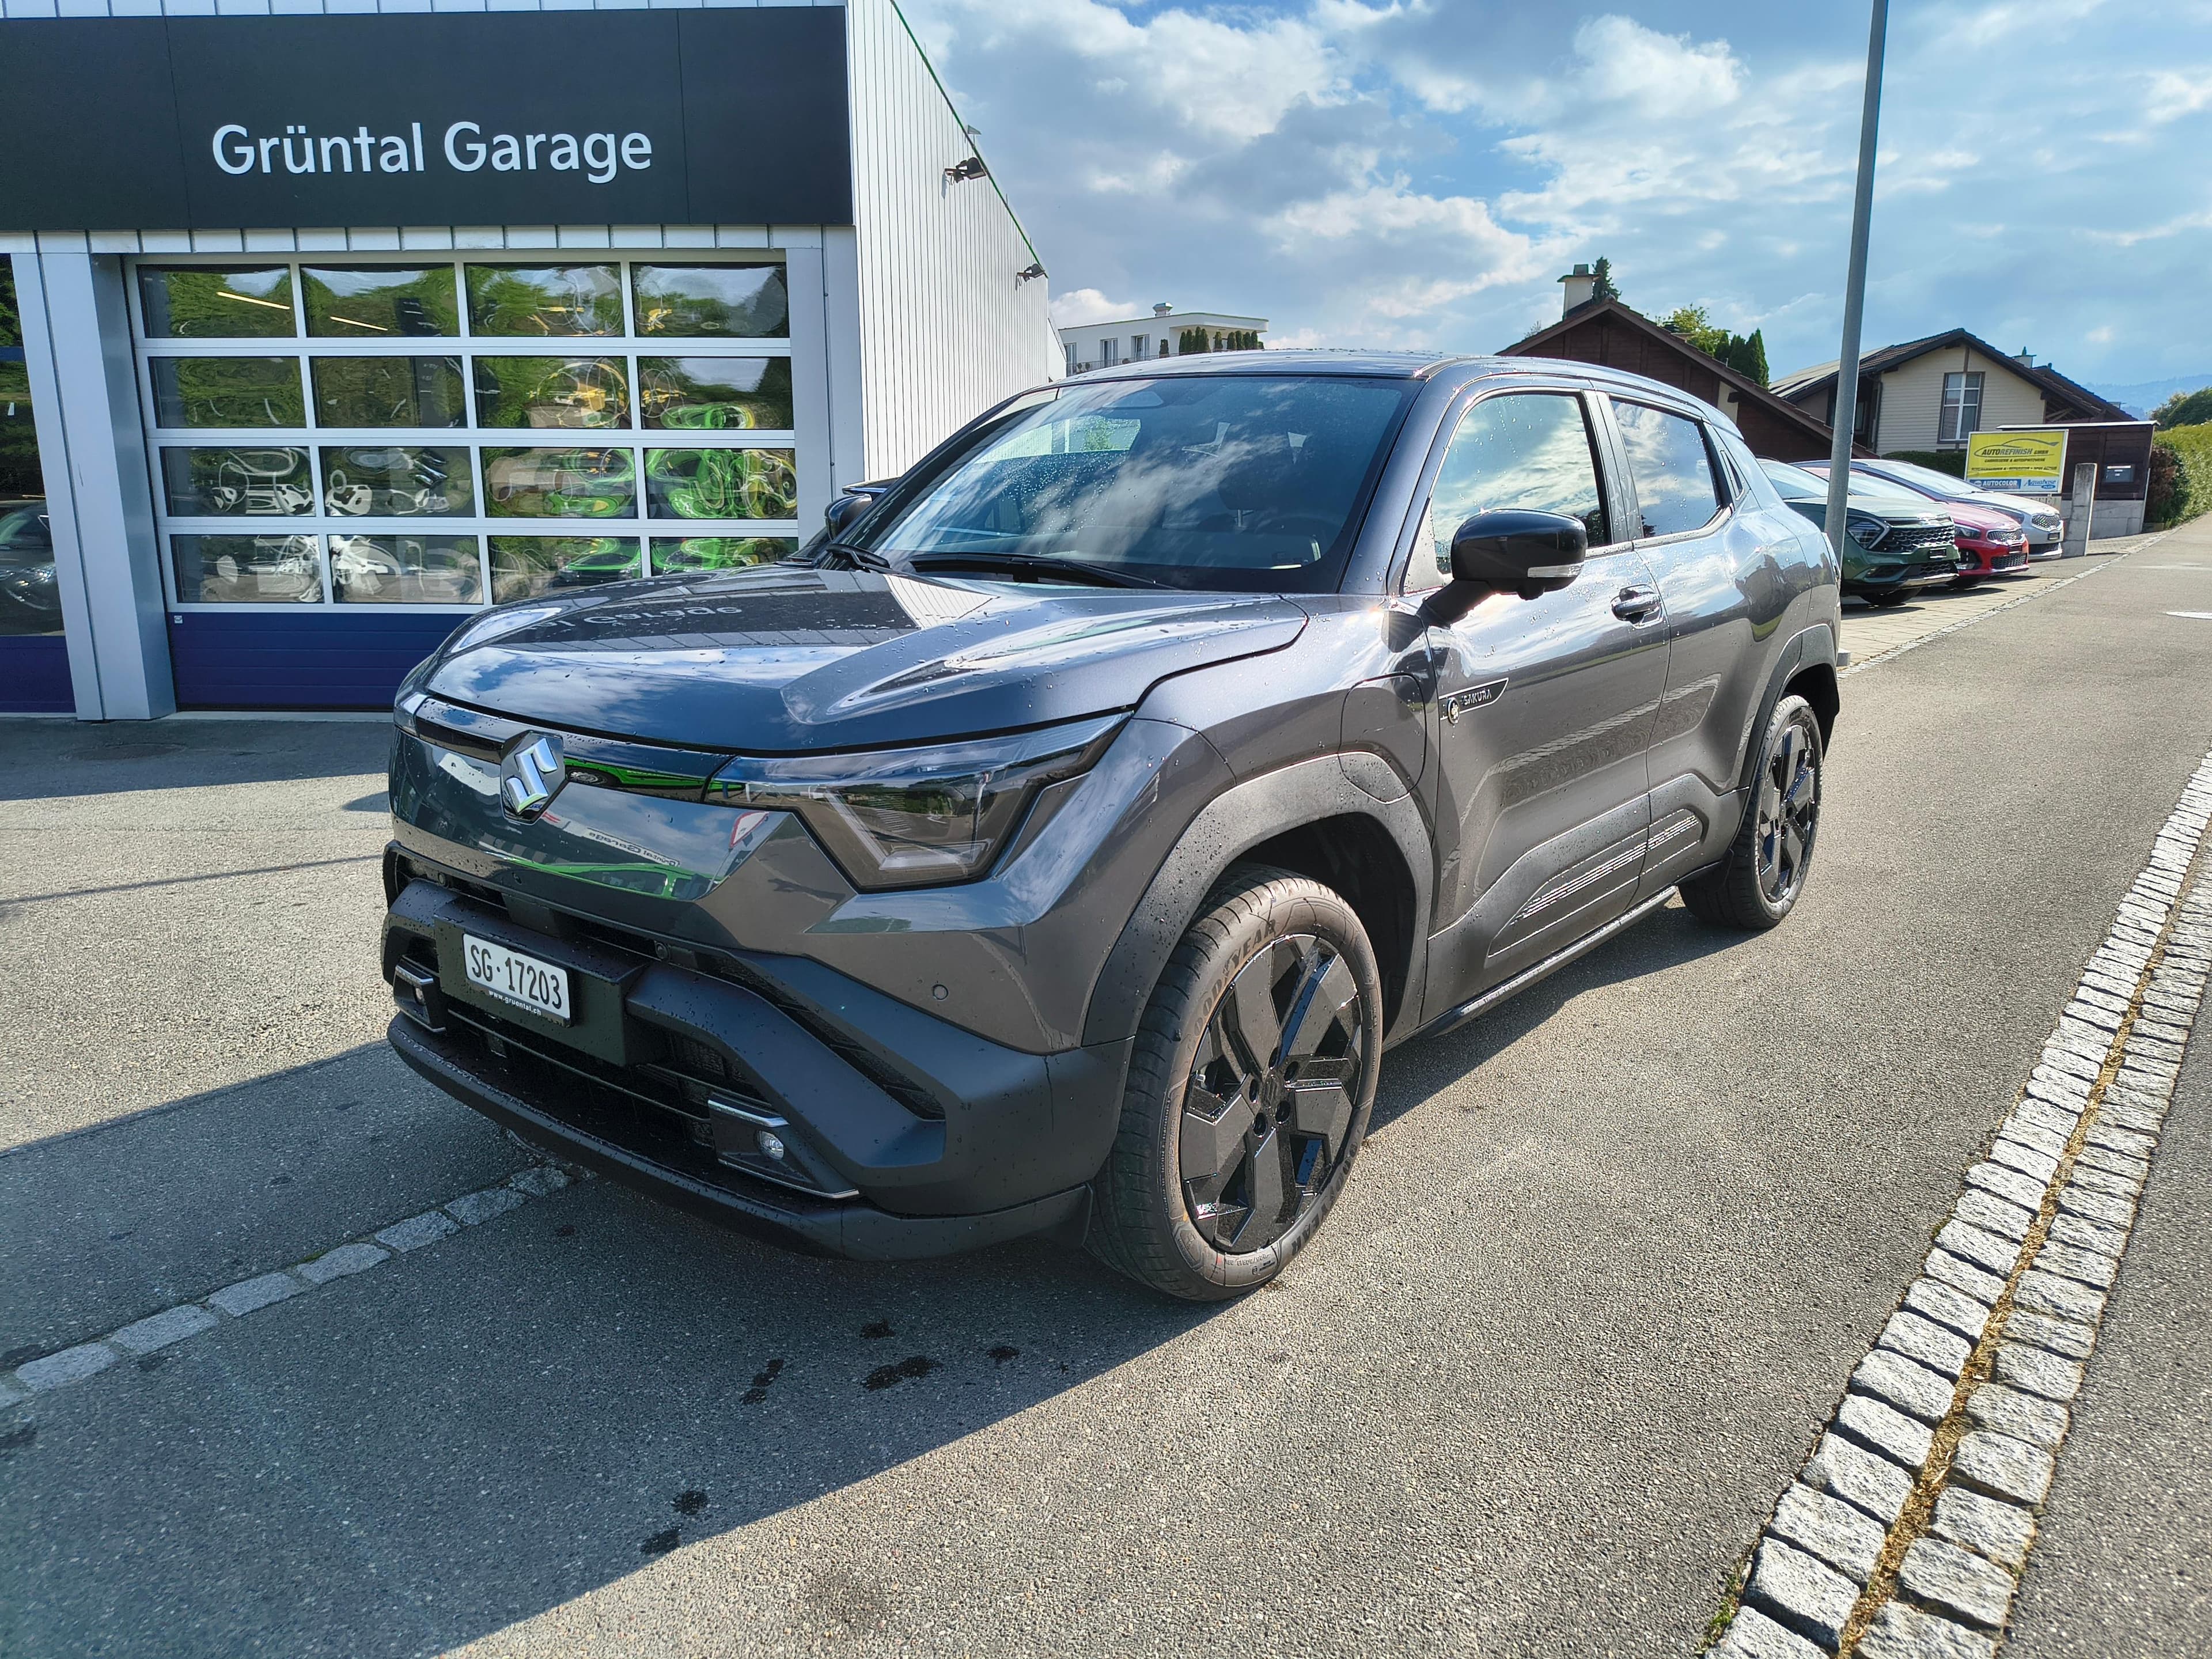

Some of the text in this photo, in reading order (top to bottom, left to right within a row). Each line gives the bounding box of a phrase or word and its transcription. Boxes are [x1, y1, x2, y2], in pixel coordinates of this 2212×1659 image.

[212, 121, 653, 184] Grüntal Garage
[1464, 689, 1492, 706] SAKURA
